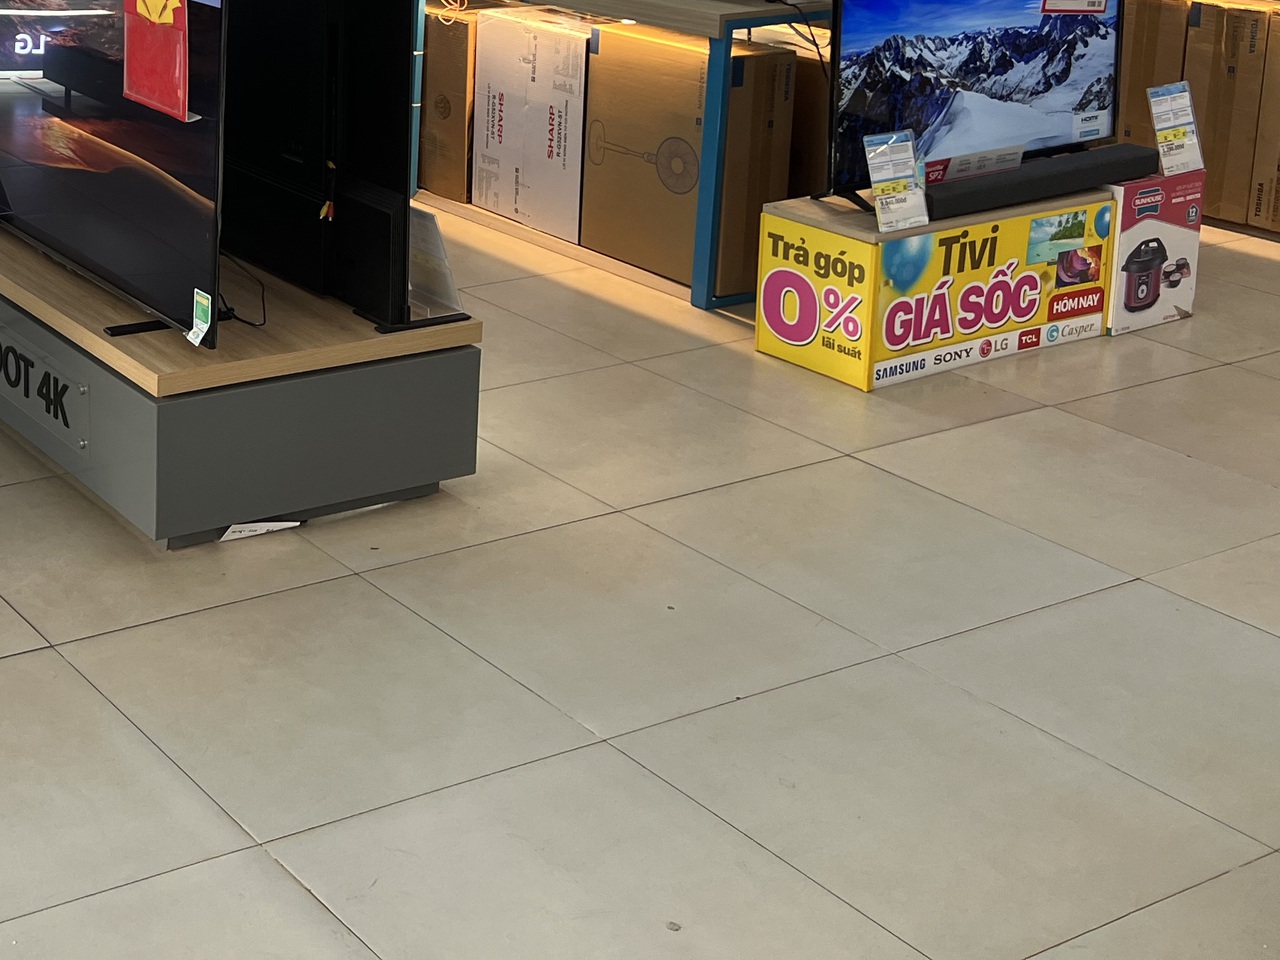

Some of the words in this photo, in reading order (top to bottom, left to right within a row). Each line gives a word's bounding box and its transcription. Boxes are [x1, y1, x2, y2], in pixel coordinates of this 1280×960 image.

[1249, 18, 1259, 55] TOSHIBA
[547, 105, 555, 160] SHARP
[1134, 194, 1163, 206] SUNHOUSE
[1189, 207, 1196, 217] 12
[1253, 182, 1264, 218] TOSHIBA
[767, 230, 810, 267] Trả
[813, 250, 865, 288] góp
[938, 224, 999, 276] Tivi
[761, 267, 863, 347] 0%
[884, 275, 954, 351] GIÁ
[958, 258, 1041, 334] SỐC
[1053, 296, 1078, 314] HÔM
[1078, 292, 1101, 309] NAY
[822, 336, 835, 351] lãi
[836, 344, 862, 361] suất
[875, 358, 926, 381] SAMSUNG
[933, 347, 974, 366] SONY
[993, 338, 1009, 353] LG
[1021, 333, 1038, 345] TCL
[1061, 322, 1095, 339] Casper
[37, 371, 70, 429] 4K
